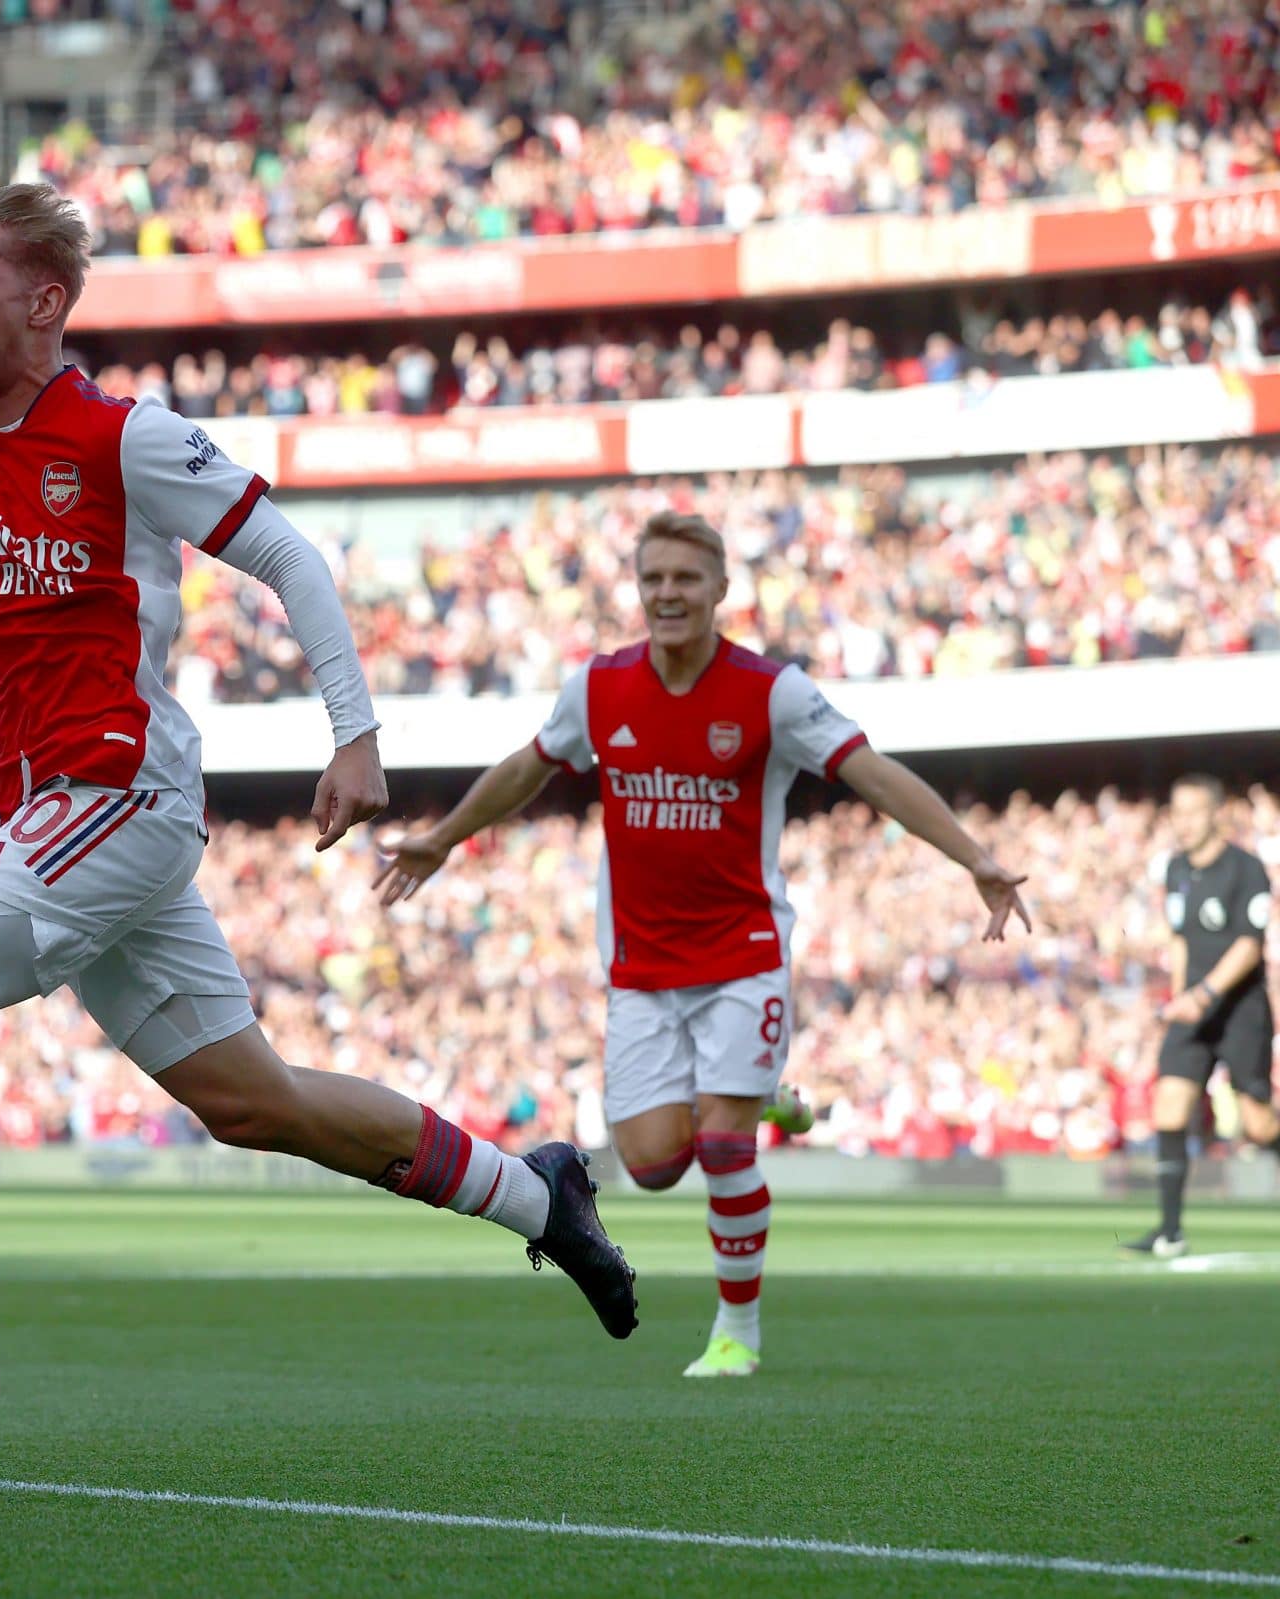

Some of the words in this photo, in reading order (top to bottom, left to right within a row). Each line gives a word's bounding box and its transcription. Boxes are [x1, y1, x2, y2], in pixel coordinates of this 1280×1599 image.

[48, 470, 77, 480] Arsenal
[606, 766, 740, 803] Emirates
[10, 791, 72, 844] 0
[626, 801, 653, 829] FLY
[656, 802, 722, 831] BETTER
[760, 997, 784, 1045] 8
